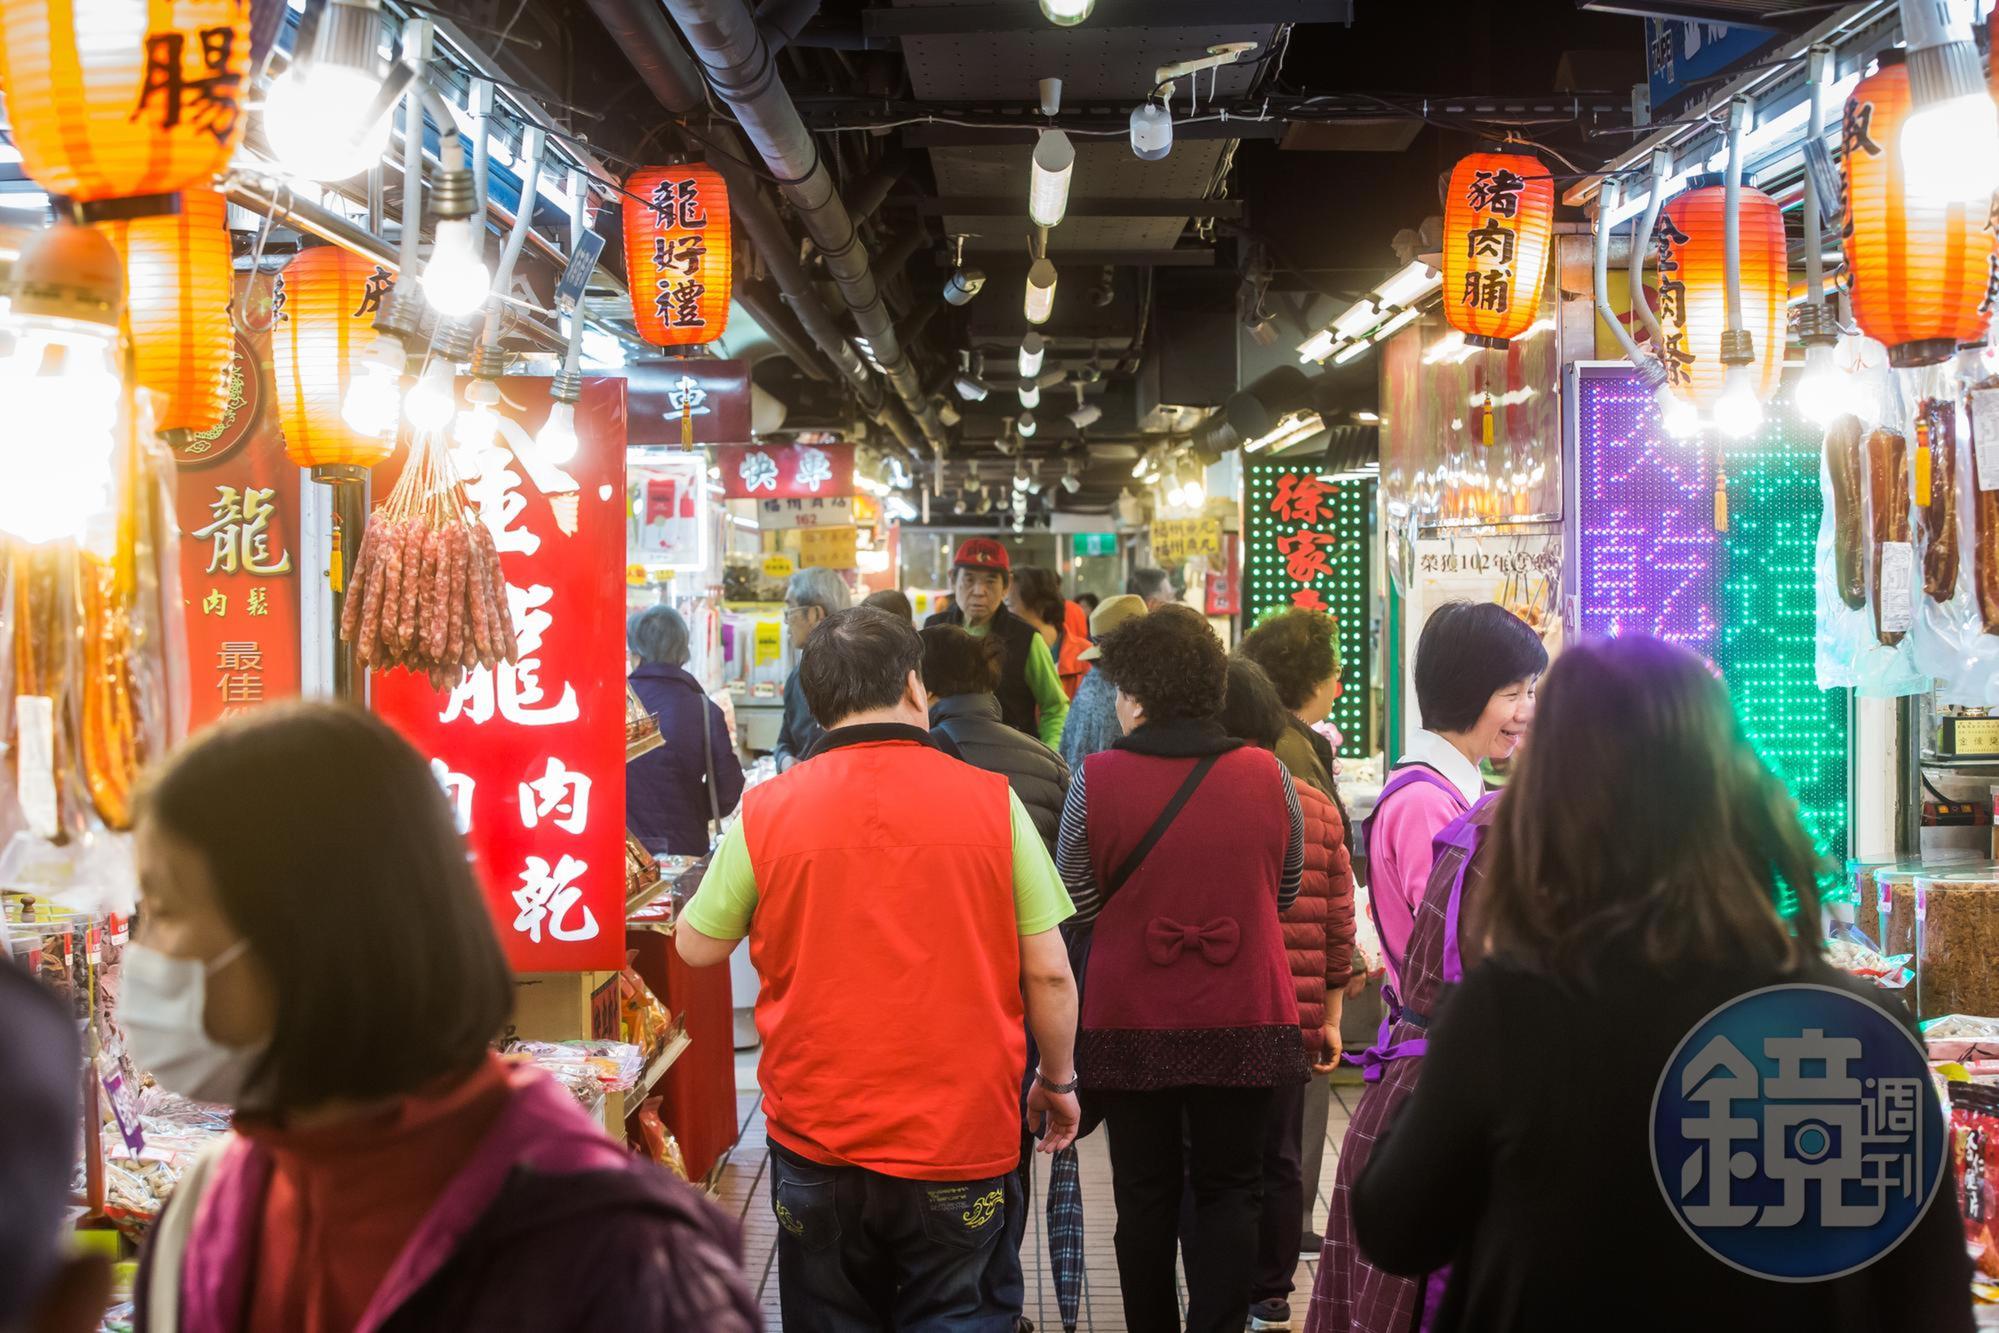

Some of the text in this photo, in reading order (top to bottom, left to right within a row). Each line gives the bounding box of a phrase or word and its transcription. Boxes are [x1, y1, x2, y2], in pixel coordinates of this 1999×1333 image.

[649, 179, 707, 328] 龍好禮
[1461, 169, 1525, 314] 豬肉脯
[512, 756, 600, 942] 肉乾
